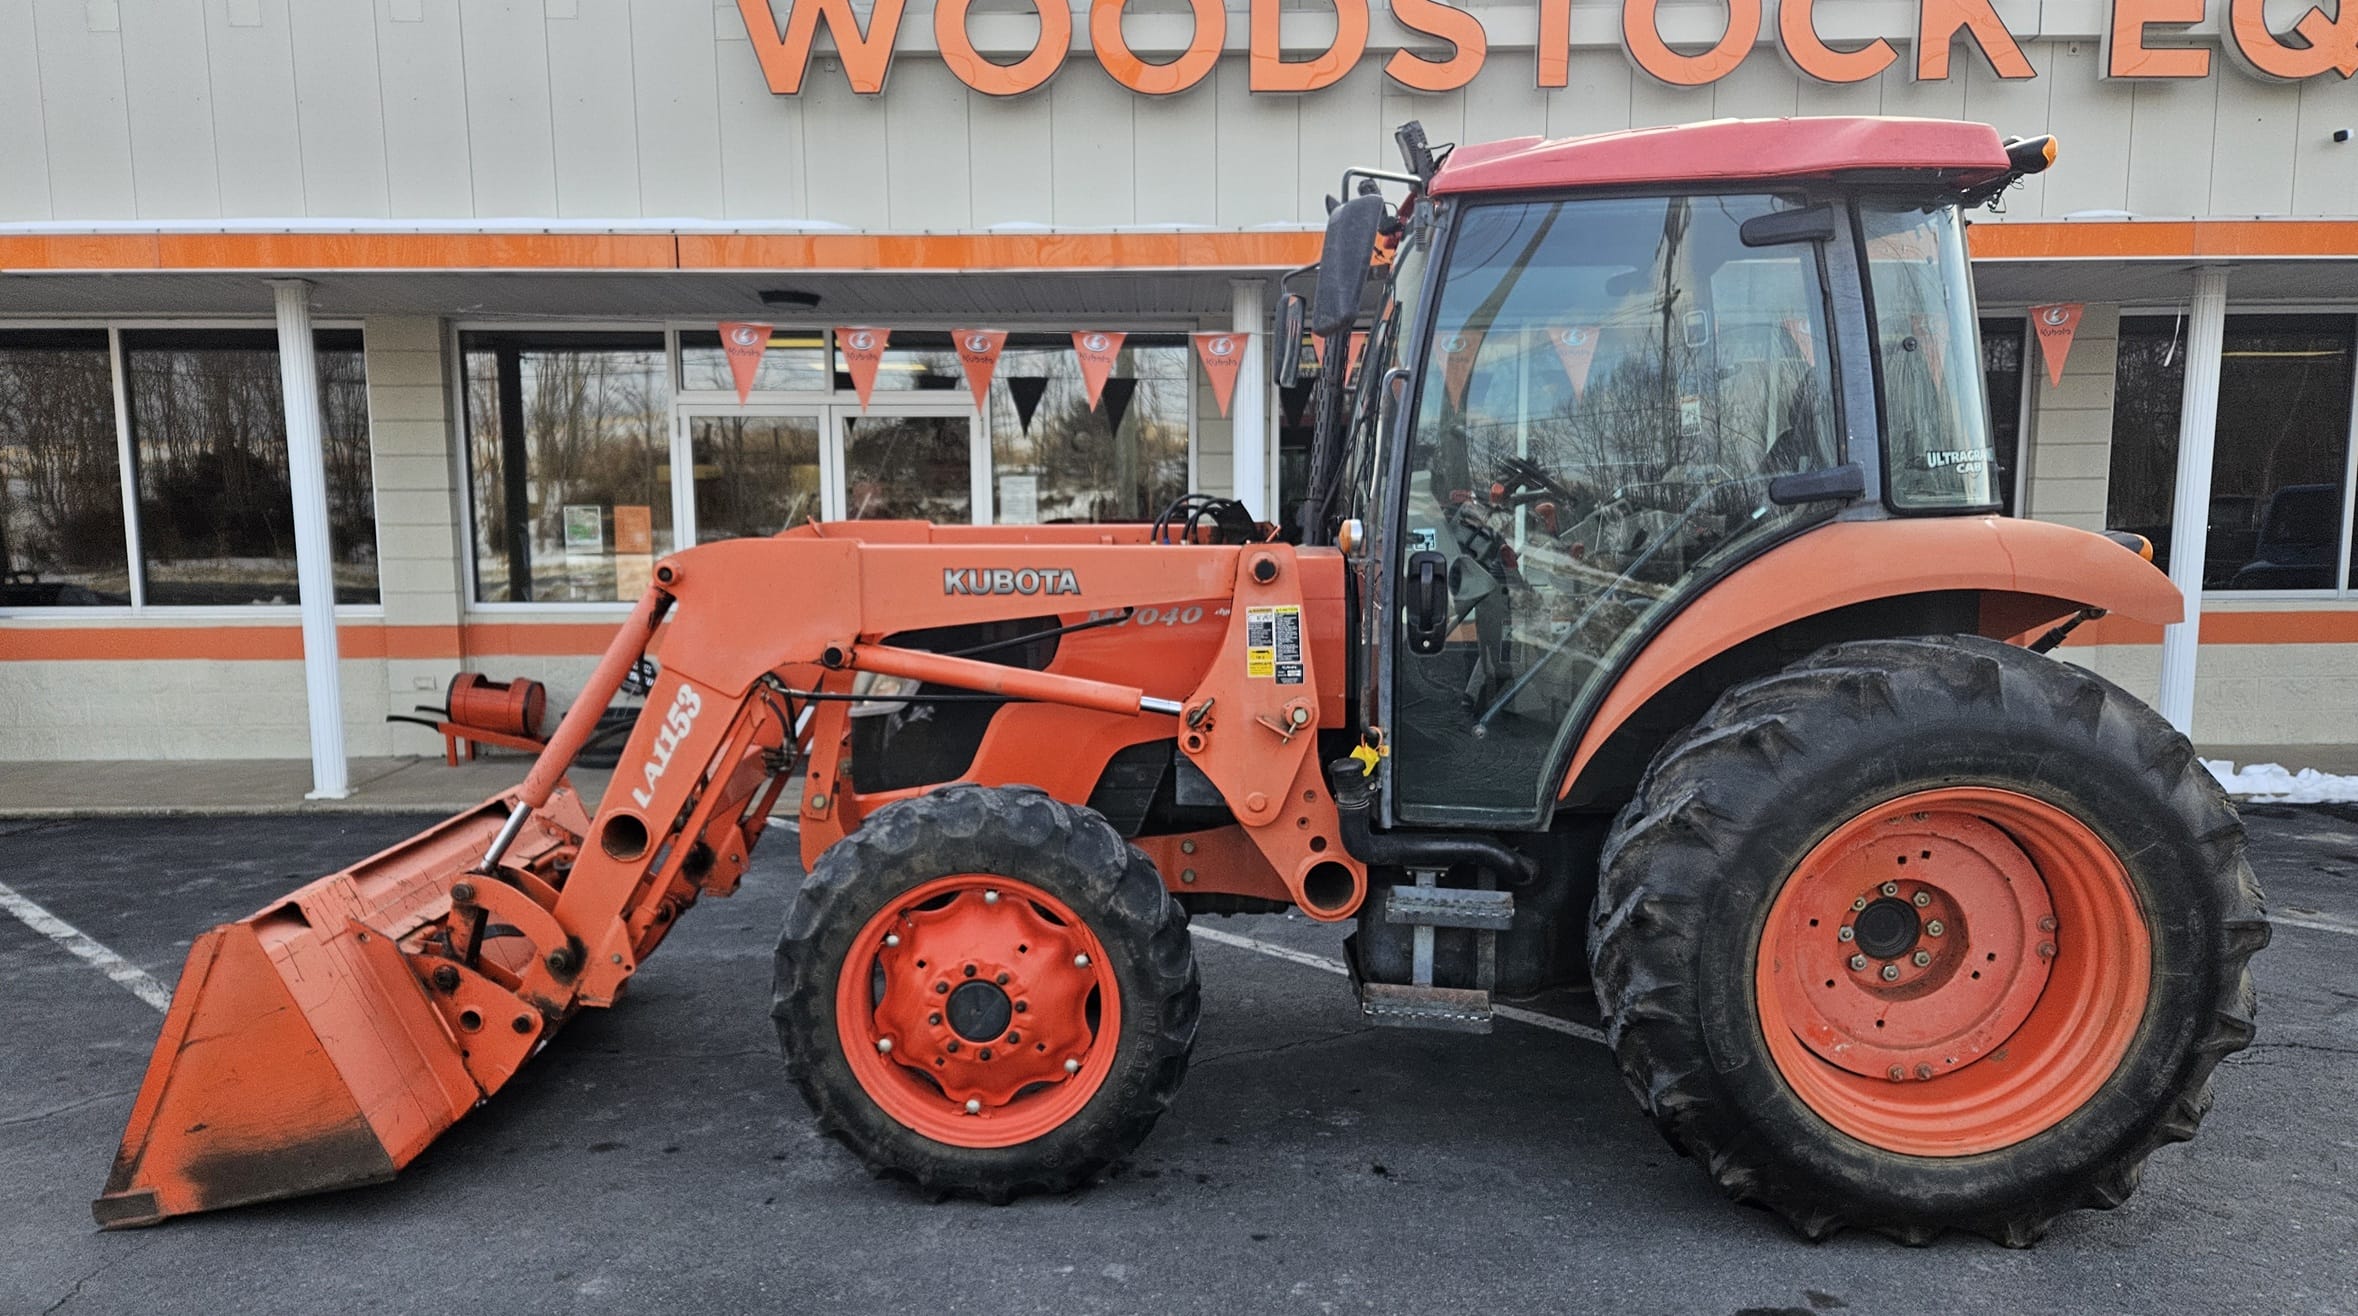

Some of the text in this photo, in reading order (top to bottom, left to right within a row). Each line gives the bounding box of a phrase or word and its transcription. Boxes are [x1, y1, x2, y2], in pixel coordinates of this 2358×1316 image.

[2041, 327, 2072, 337] Kubota
[962, 355, 993, 365] Kubota
[1205, 358, 1238, 368] Kubota
[1956, 461, 1982, 473] CAB
[944, 568, 1082, 595] KUBOTA
[632, 683, 702, 809] LA1153
